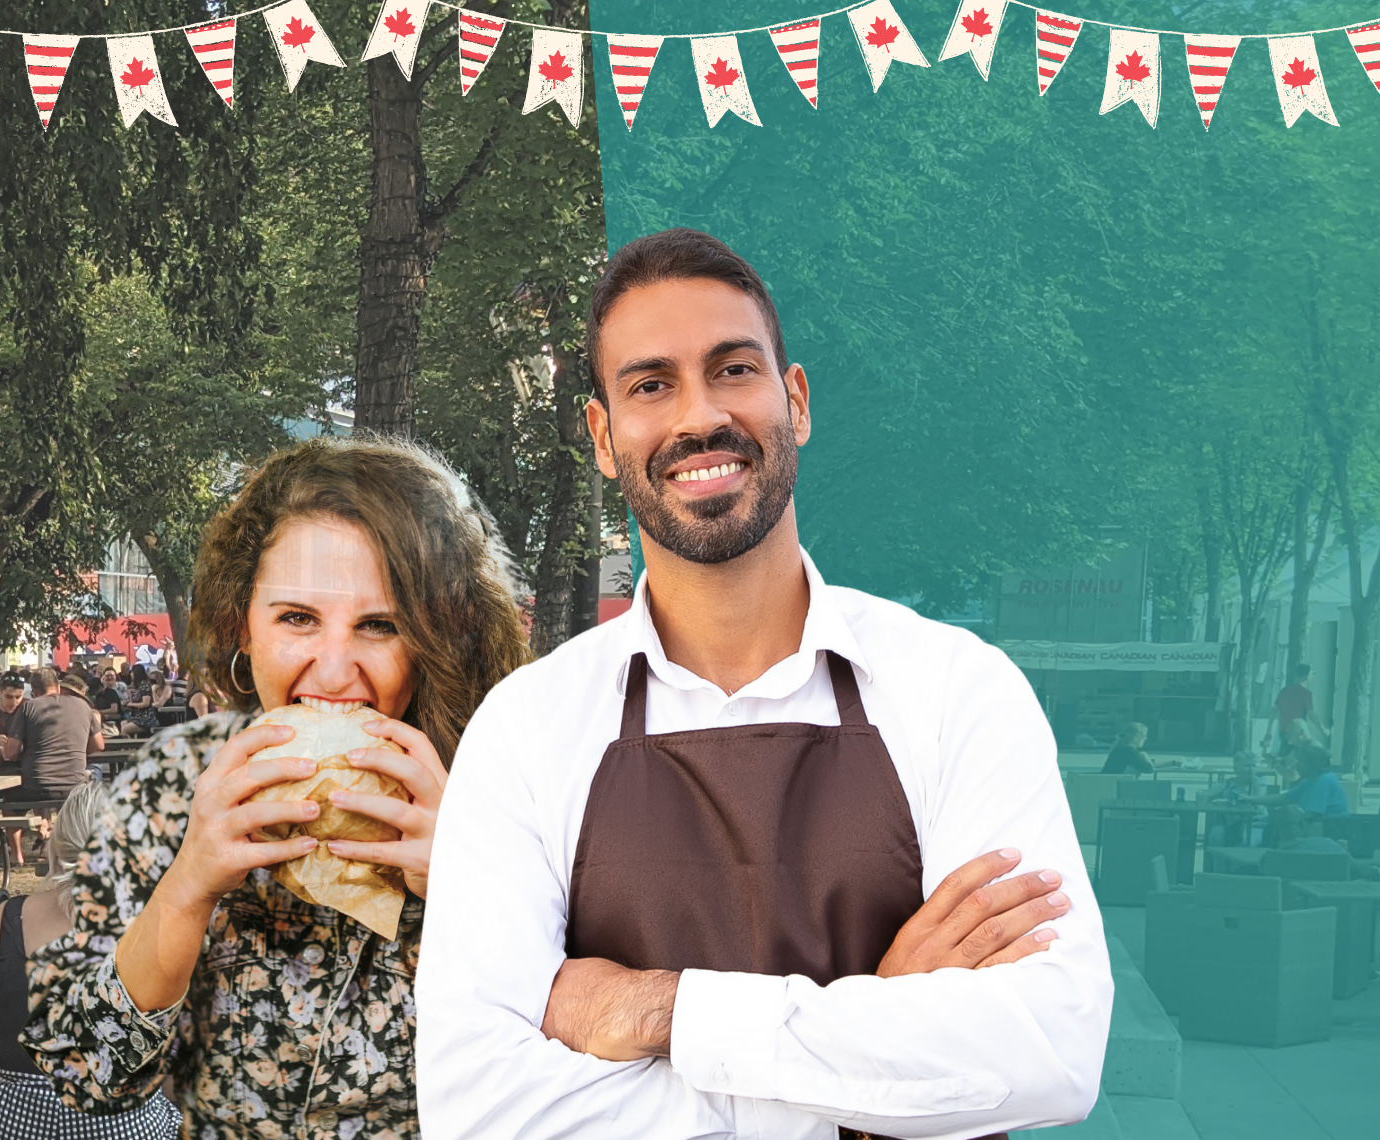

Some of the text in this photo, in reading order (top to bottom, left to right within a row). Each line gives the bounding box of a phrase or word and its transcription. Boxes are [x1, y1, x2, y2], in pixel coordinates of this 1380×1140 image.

[1019, 579, 1124, 594] ROSENAU
[1100, 652, 1157, 661] CANADIAN
[1161, 653, 1218, 662] CANADIAN
